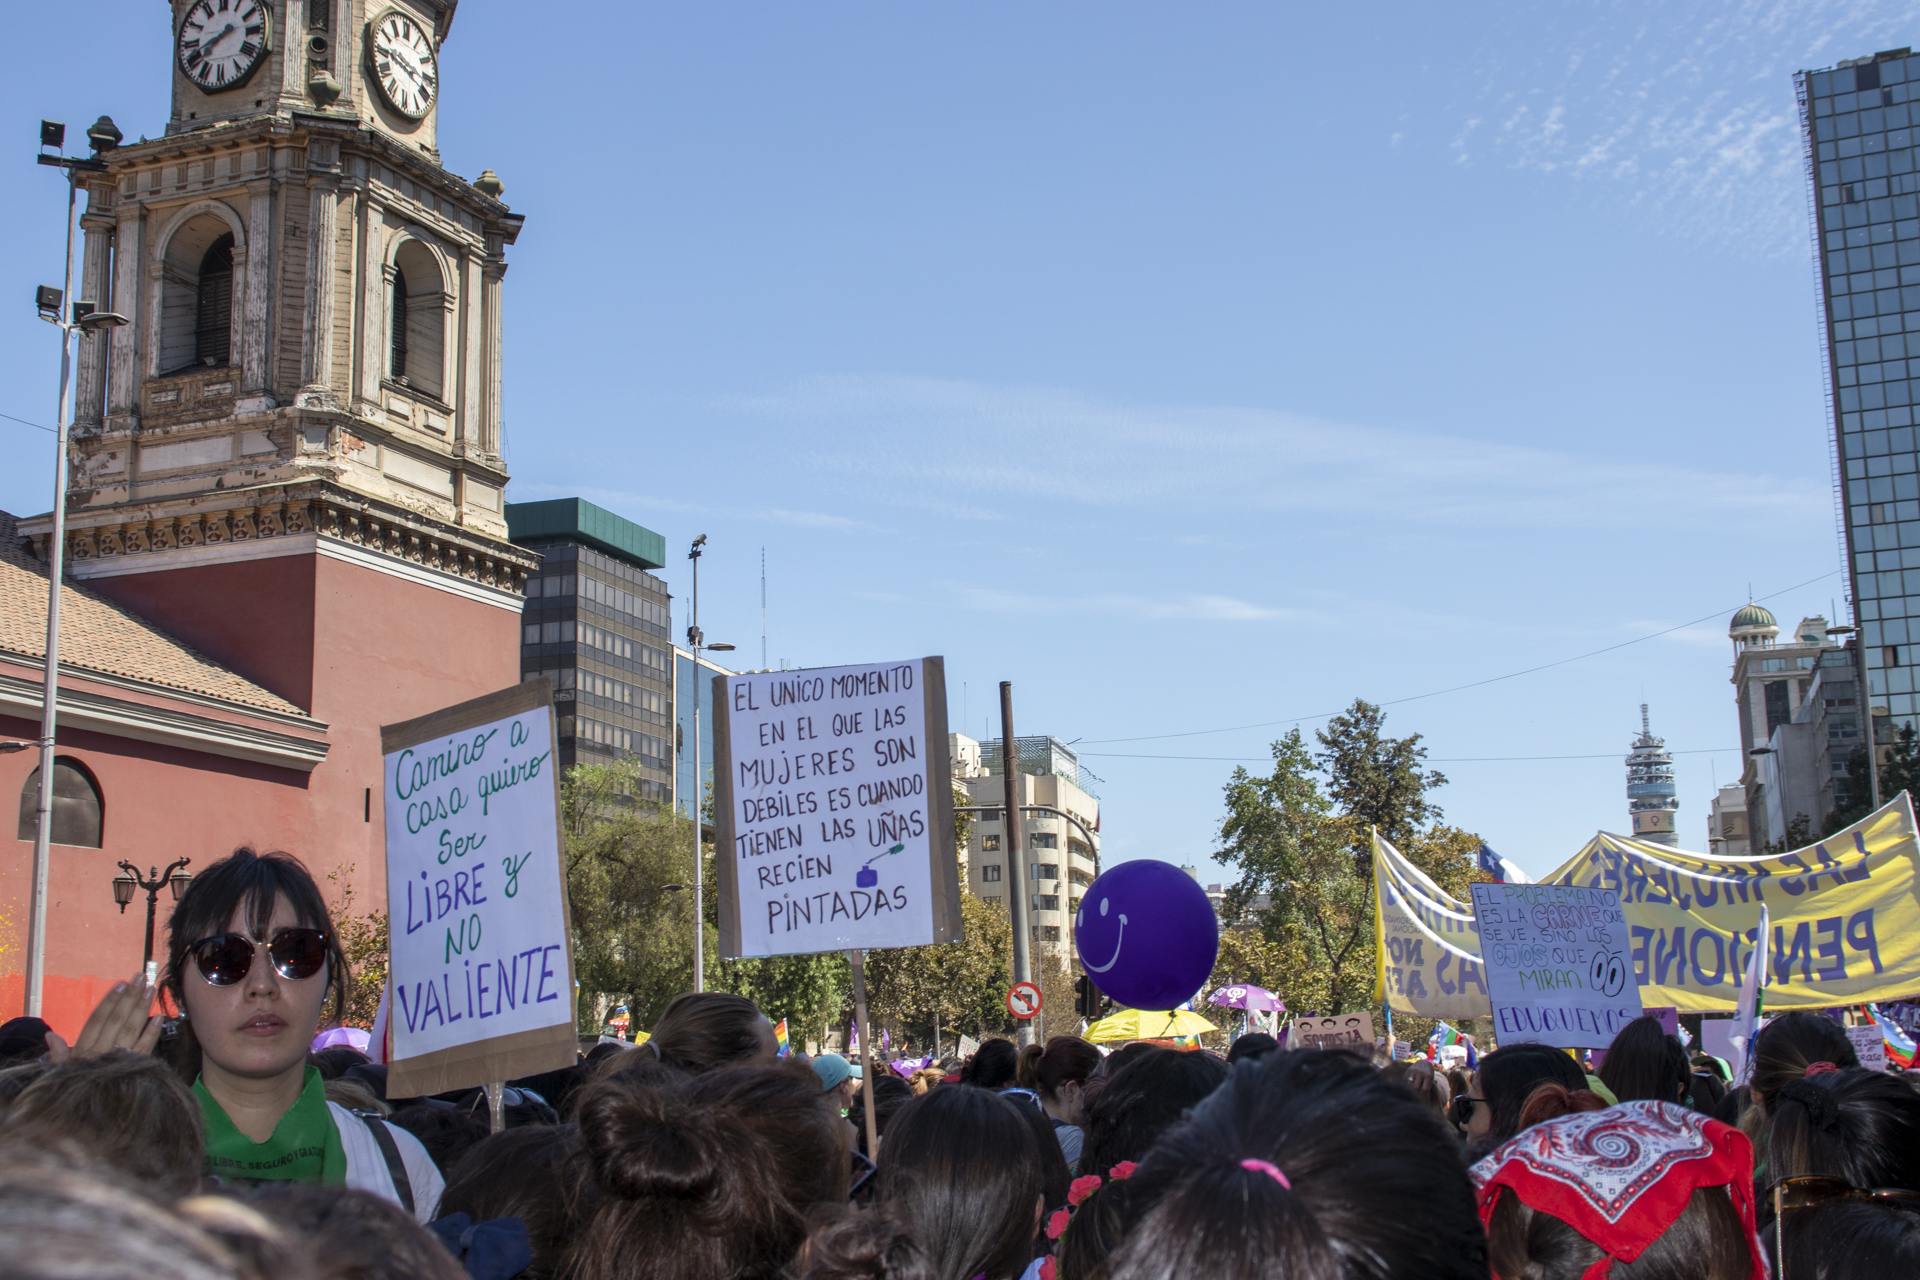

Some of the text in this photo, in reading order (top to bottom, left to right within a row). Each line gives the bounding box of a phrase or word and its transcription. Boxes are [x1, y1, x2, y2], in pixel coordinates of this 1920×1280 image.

[734, 681, 760, 712] EL
[831, 665, 913, 700] MOMENTO
[759, 705, 906, 747] EN EL QUE LAS
[396, 720, 530, 800] Camino a
[874, 735, 916, 767] SON
[407, 749, 552, 835] casa quiero
[828, 787, 851, 812] ES
[857, 773, 923, 807] CUANDO
[821, 818, 856, 843] LAS
[868, 810, 925, 847] UÑAS
[1475, 885, 1616, 907] EL PROBLEMA NO
[1481, 904, 1625, 929] ES LA CARNE QUE
[445, 913, 482, 964] NO
[1484, 929, 1503, 941] SE
[1540, 930, 1576, 943] SINO
[1586, 927, 1612, 944] LOS
[1492, 943, 1588, 969] OJOS QUE
[247, 1152, 294, 1170] SEGURO
